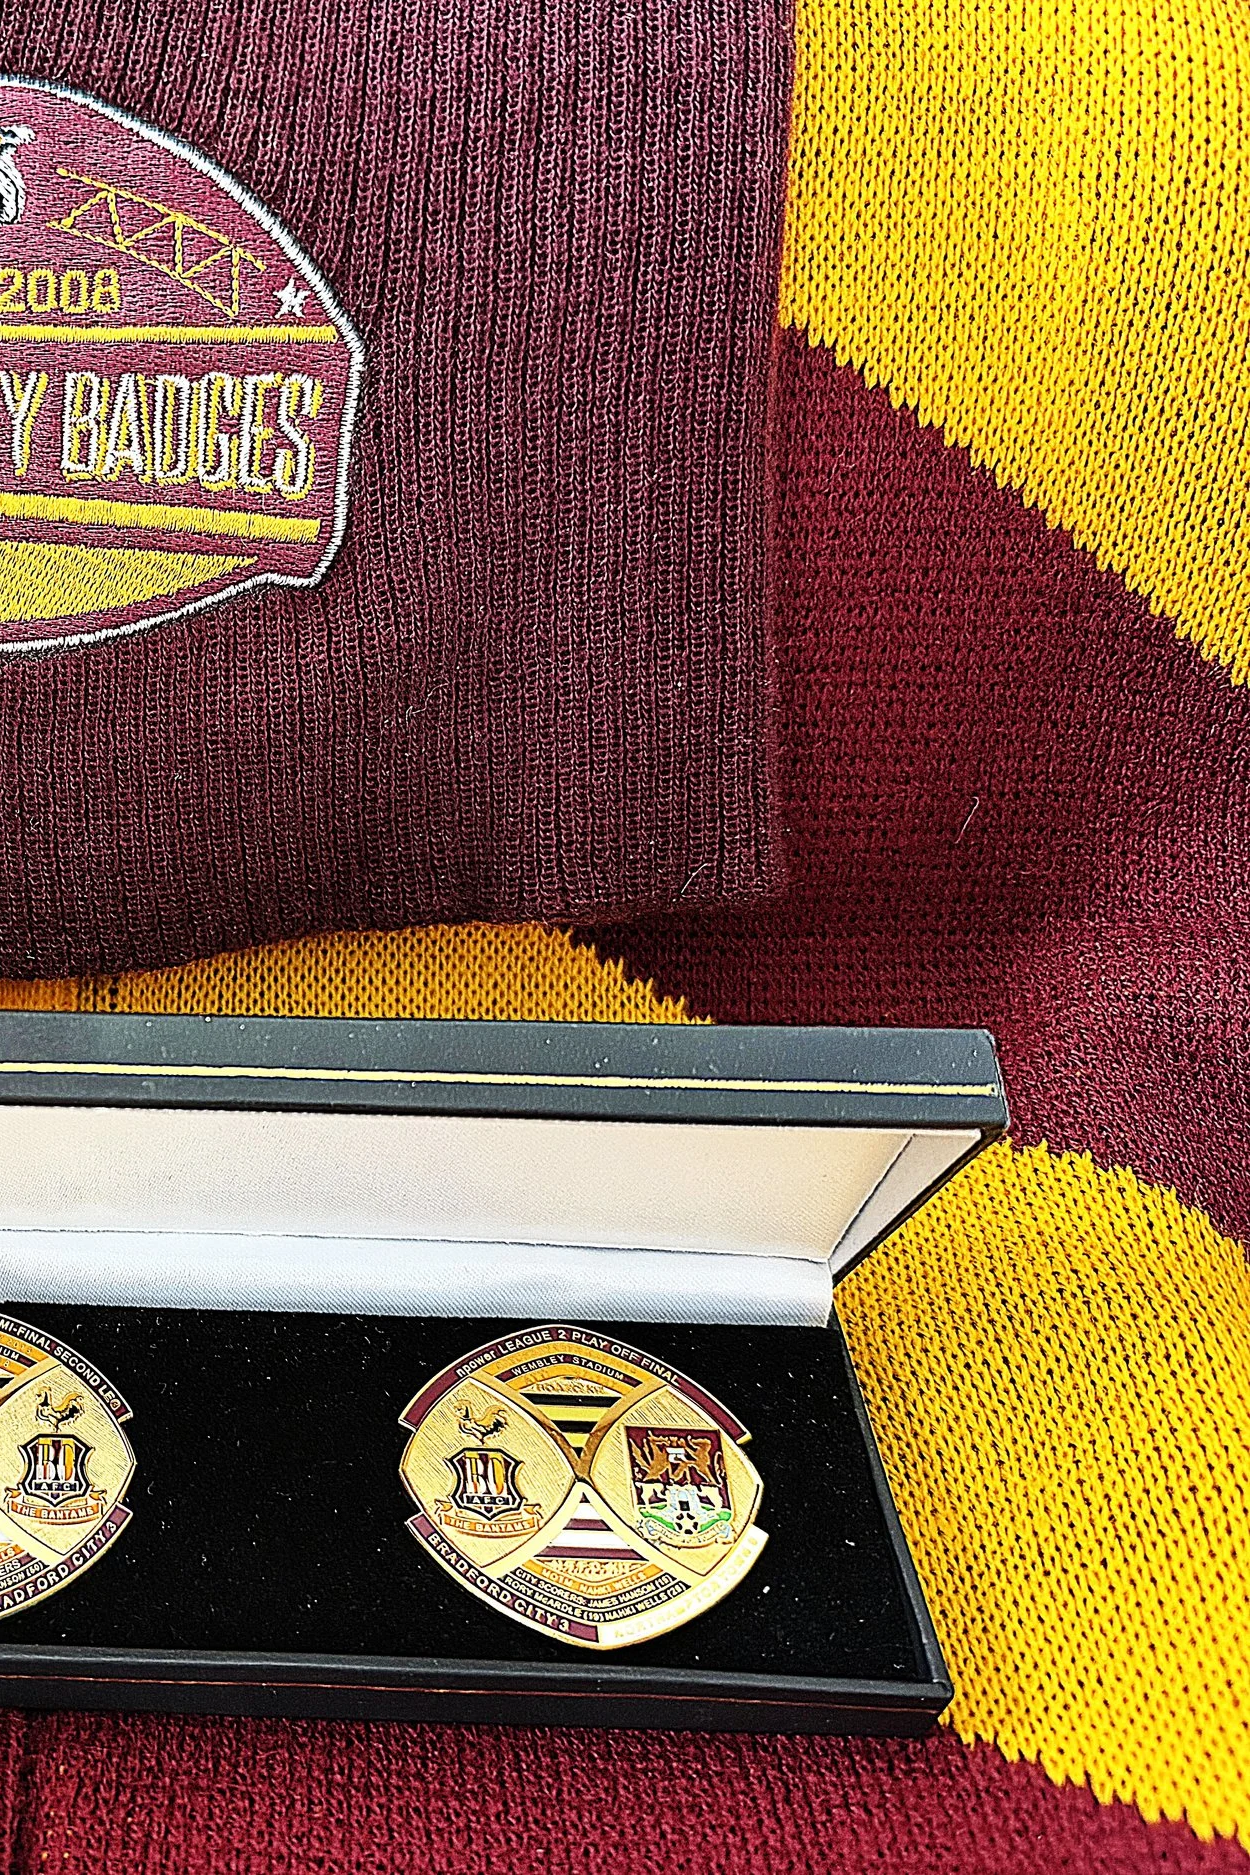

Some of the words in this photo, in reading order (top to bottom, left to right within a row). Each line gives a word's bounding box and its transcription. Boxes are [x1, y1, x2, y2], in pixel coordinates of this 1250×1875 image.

[61, 371, 324, 502] BADGES
[53, 1347, 100, 1385] SECOND
[98, 1384, 122, 1410] LEG
[455, 1351, 498, 1378] npower
[497, 1330, 552, 1355] LEAGUE
[557, 1329, 567, 1340] 2
[572, 1331, 608, 1350] PLAY
[610, 1344, 641, 1365] OFF
[640, 1357, 682, 1388] FINAL
[511, 1354, 565, 1376] WEMBLEY
[572, 1357, 625, 1381] STADIUM
[16, 1504, 36, 1517] THE
[40, 1507, 93, 1519] BANTAMS
[449, 1518, 470, 1530] THE
[475, 1520, 532, 1533] BANTAMS
[71, 1530, 107, 1568] CITY
[106, 1521, 118, 1534] 3
[428, 1533, 511, 1604] BRADFORD
[514, 1599, 558, 1626] CITY
[558, 1619, 571, 1632] 3
[505, 1576, 534, 1597] RORY
[637, 1593, 666, 1611] WELLS
[515, 1568, 538, 1585] CITY
[588, 1597, 618, 1608] JAMES
[618, 1583, 656, 1602] HANSON
